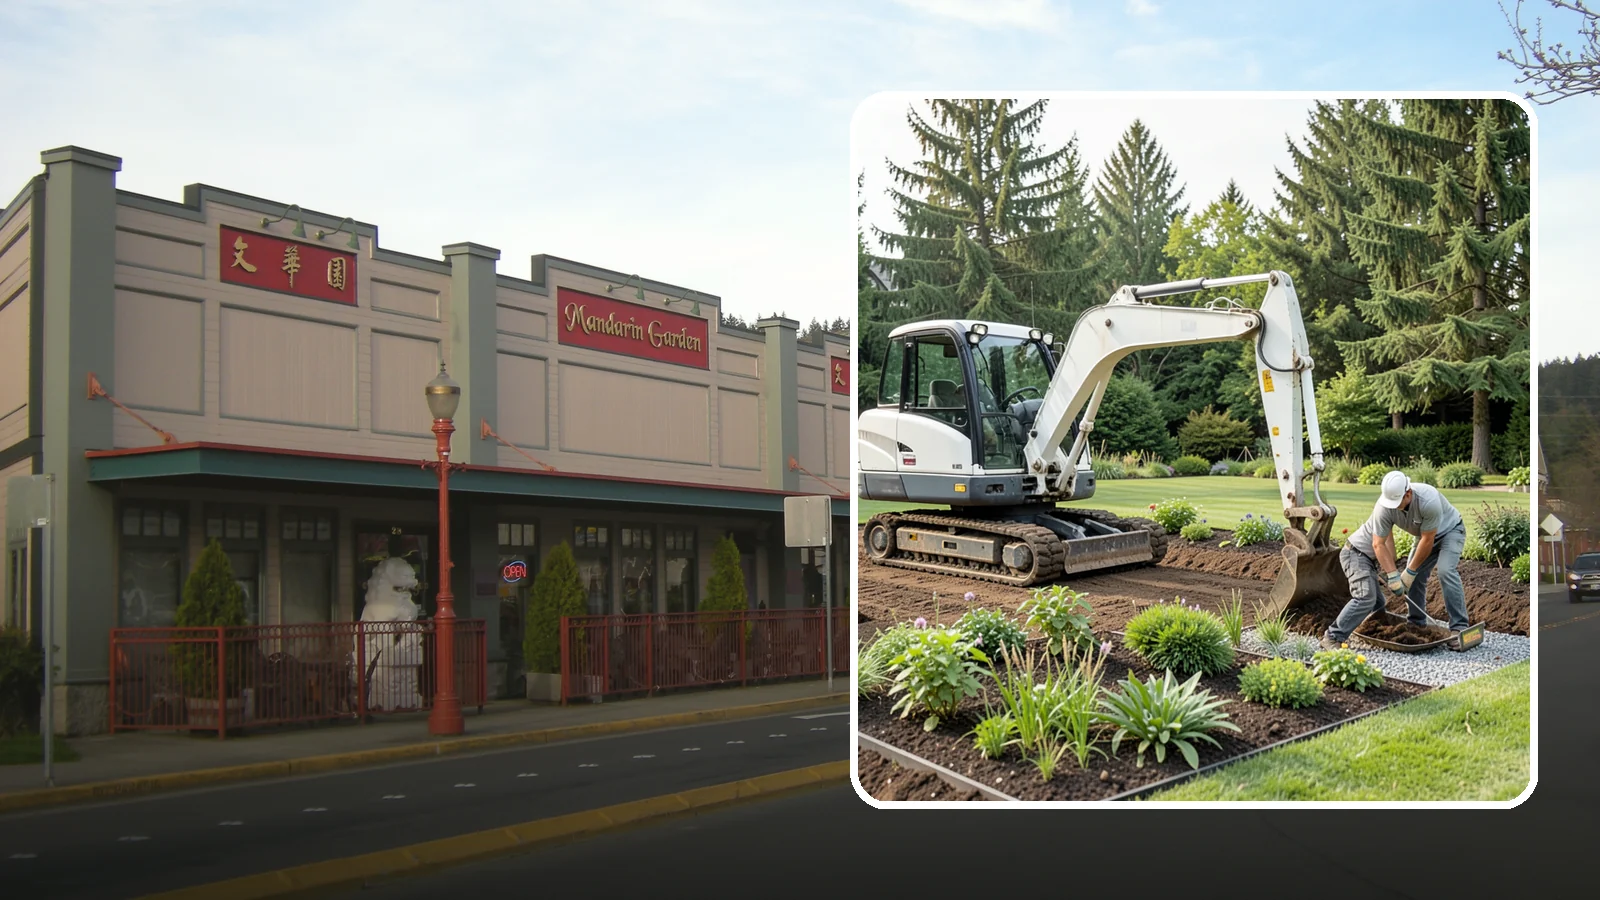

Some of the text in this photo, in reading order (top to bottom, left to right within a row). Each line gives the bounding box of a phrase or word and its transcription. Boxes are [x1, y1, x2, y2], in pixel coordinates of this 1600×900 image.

[230, 235, 346, 290] 文華園
[564, 302, 701, 352] Mandarin Garden
[503, 565, 526, 578] OPEN
